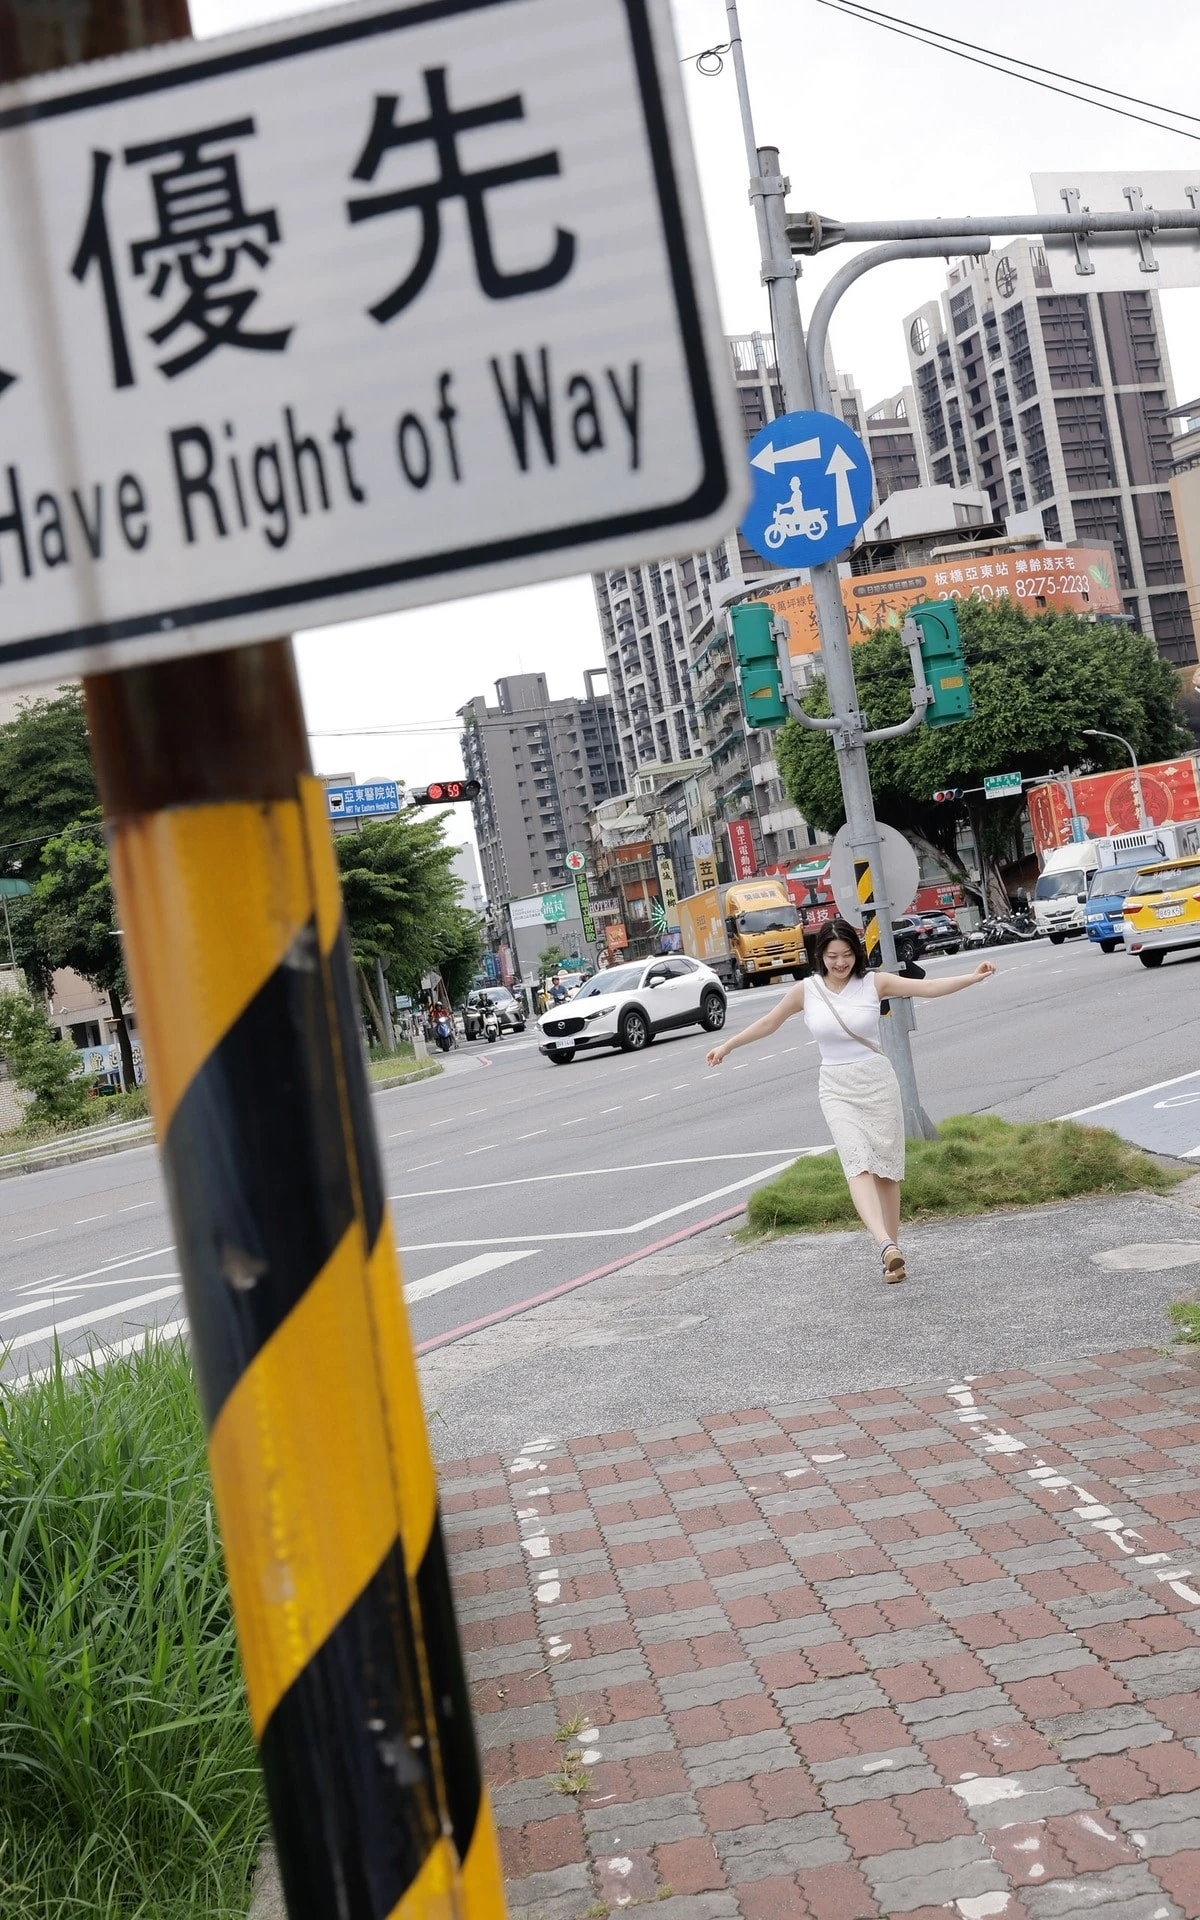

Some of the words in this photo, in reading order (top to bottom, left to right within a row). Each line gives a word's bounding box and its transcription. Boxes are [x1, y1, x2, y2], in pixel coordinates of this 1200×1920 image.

[0, 66, 578, 402] 優先
[0, 466, 148, 585] Have
[169, 407, 365, 549] Right
[397, 371, 462, 490] of
[491, 344, 642, 474] Way
[934, 562, 1009, 586] 板橋亞東站
[1015, 556, 1076, 573] 樂齡透天宅
[1015, 575, 1090, 598] 8275-2233
[343, 785, 396, 803] 亞東醫院站
